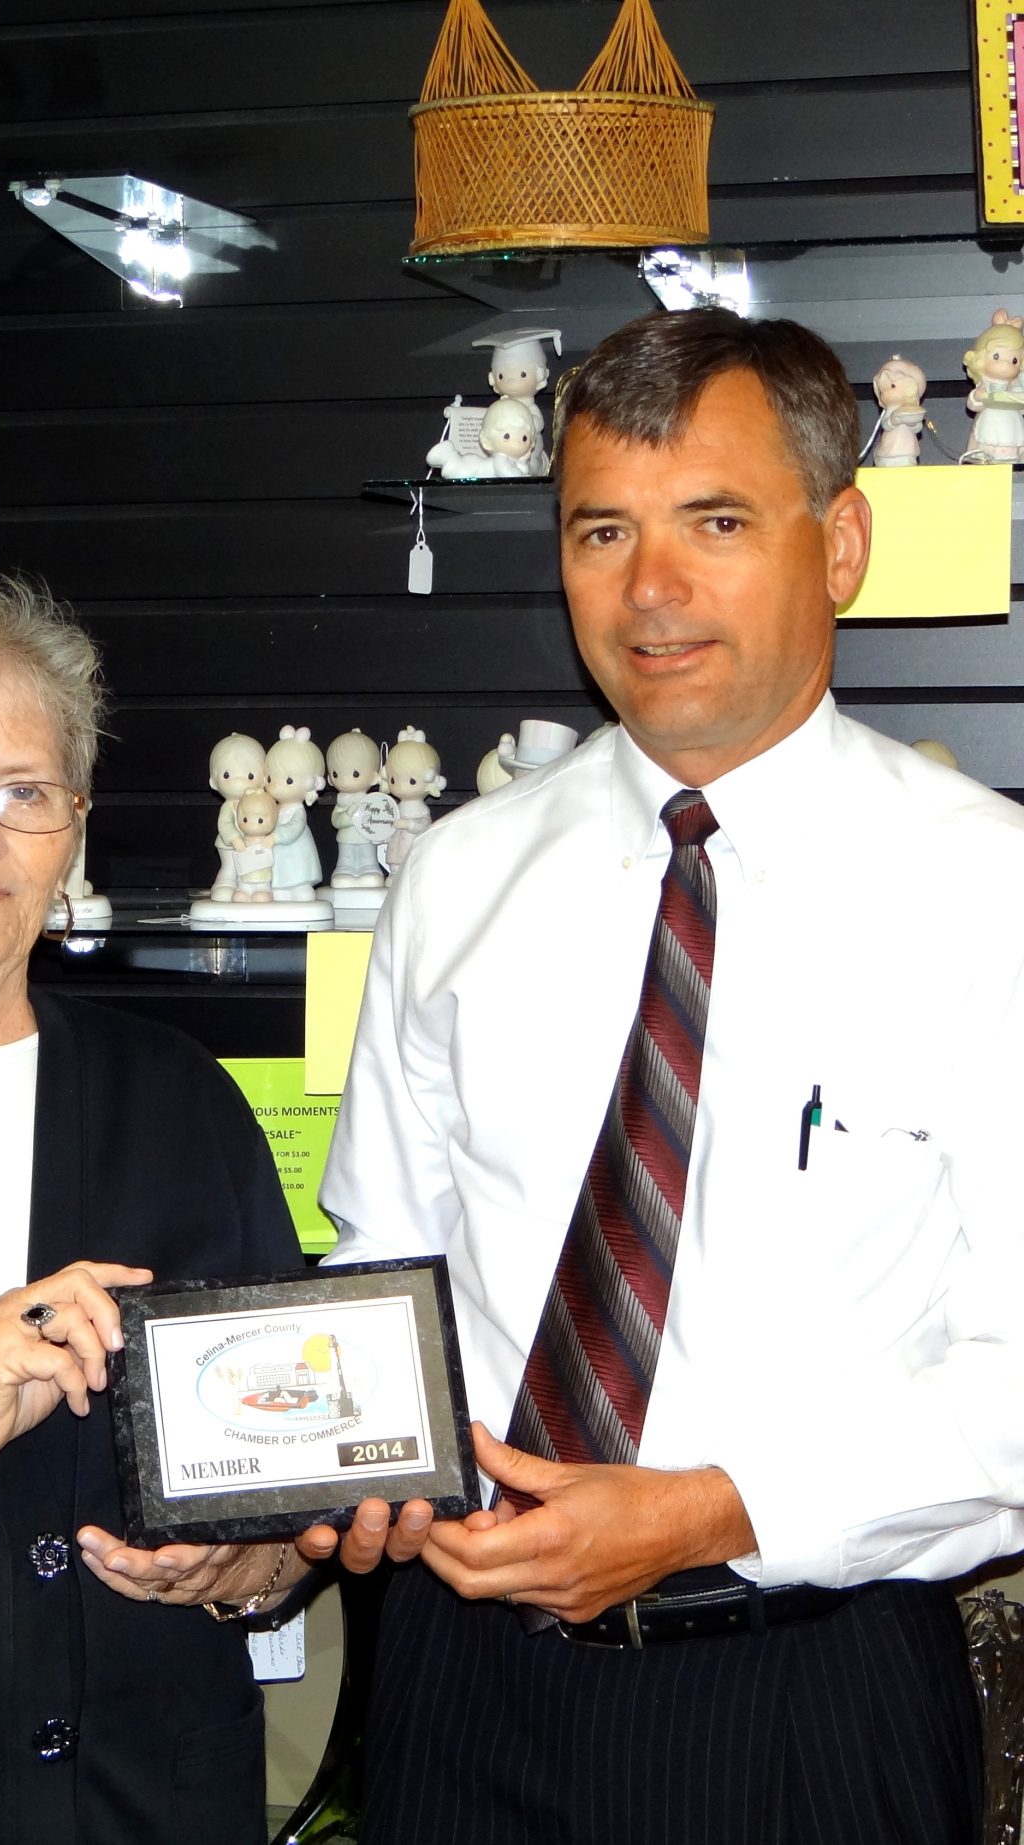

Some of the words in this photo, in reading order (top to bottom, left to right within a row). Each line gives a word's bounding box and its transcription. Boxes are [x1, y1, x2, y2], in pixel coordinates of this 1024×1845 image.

[281, 1106, 340, 1117] MOMENTS
[195, 1328, 261, 1367] Celina-Mercer
[264, 1323, 302, 1334] County
[223, 1427, 279, 1445] CHAMBER
[282, 1435, 298, 1445] OF
[300, 1416, 363, 1443] COMMERCE
[352, 1440, 405, 1463] 2014
[181, 1457, 261, 1481] MEMBER
